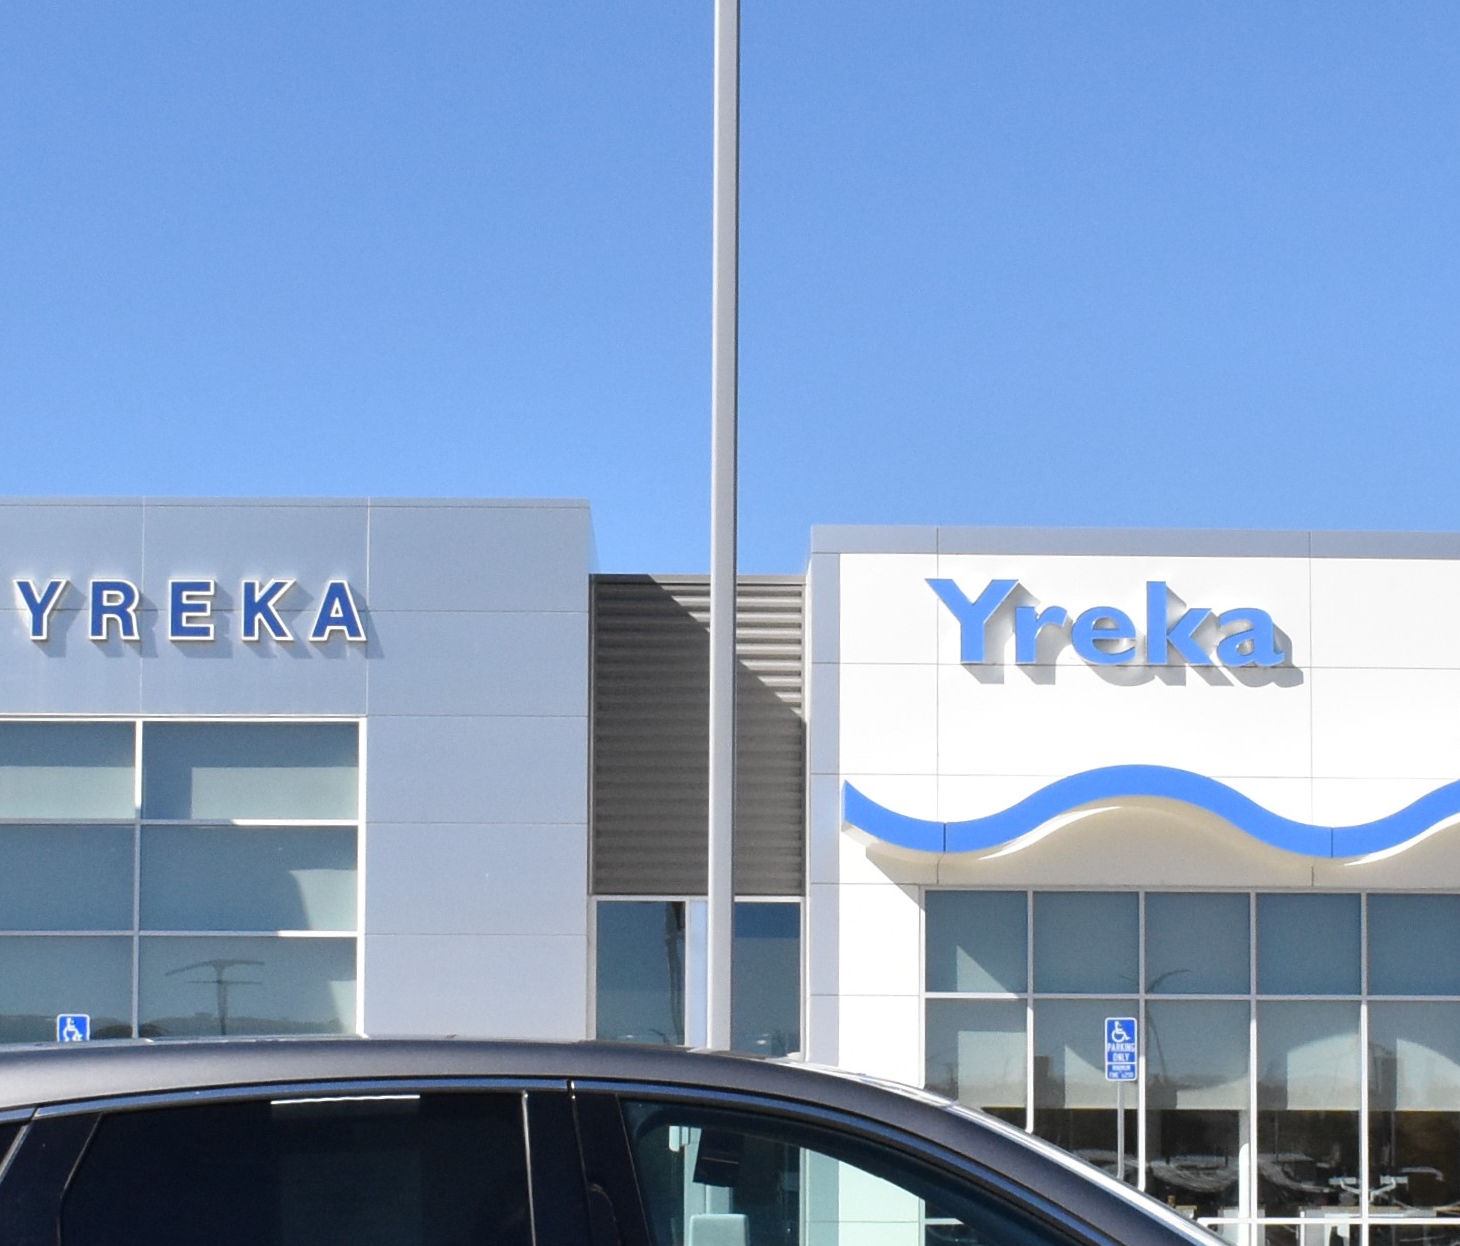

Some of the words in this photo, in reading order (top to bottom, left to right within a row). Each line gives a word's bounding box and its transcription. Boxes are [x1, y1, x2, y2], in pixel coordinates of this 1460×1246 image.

[14, 578, 367, 642] YREKA
[925, 577, 1285, 669] Yreka
[1107, 1043, 1136, 1052] PARKING
[1112, 1052, 1130, 1062] ONLY
